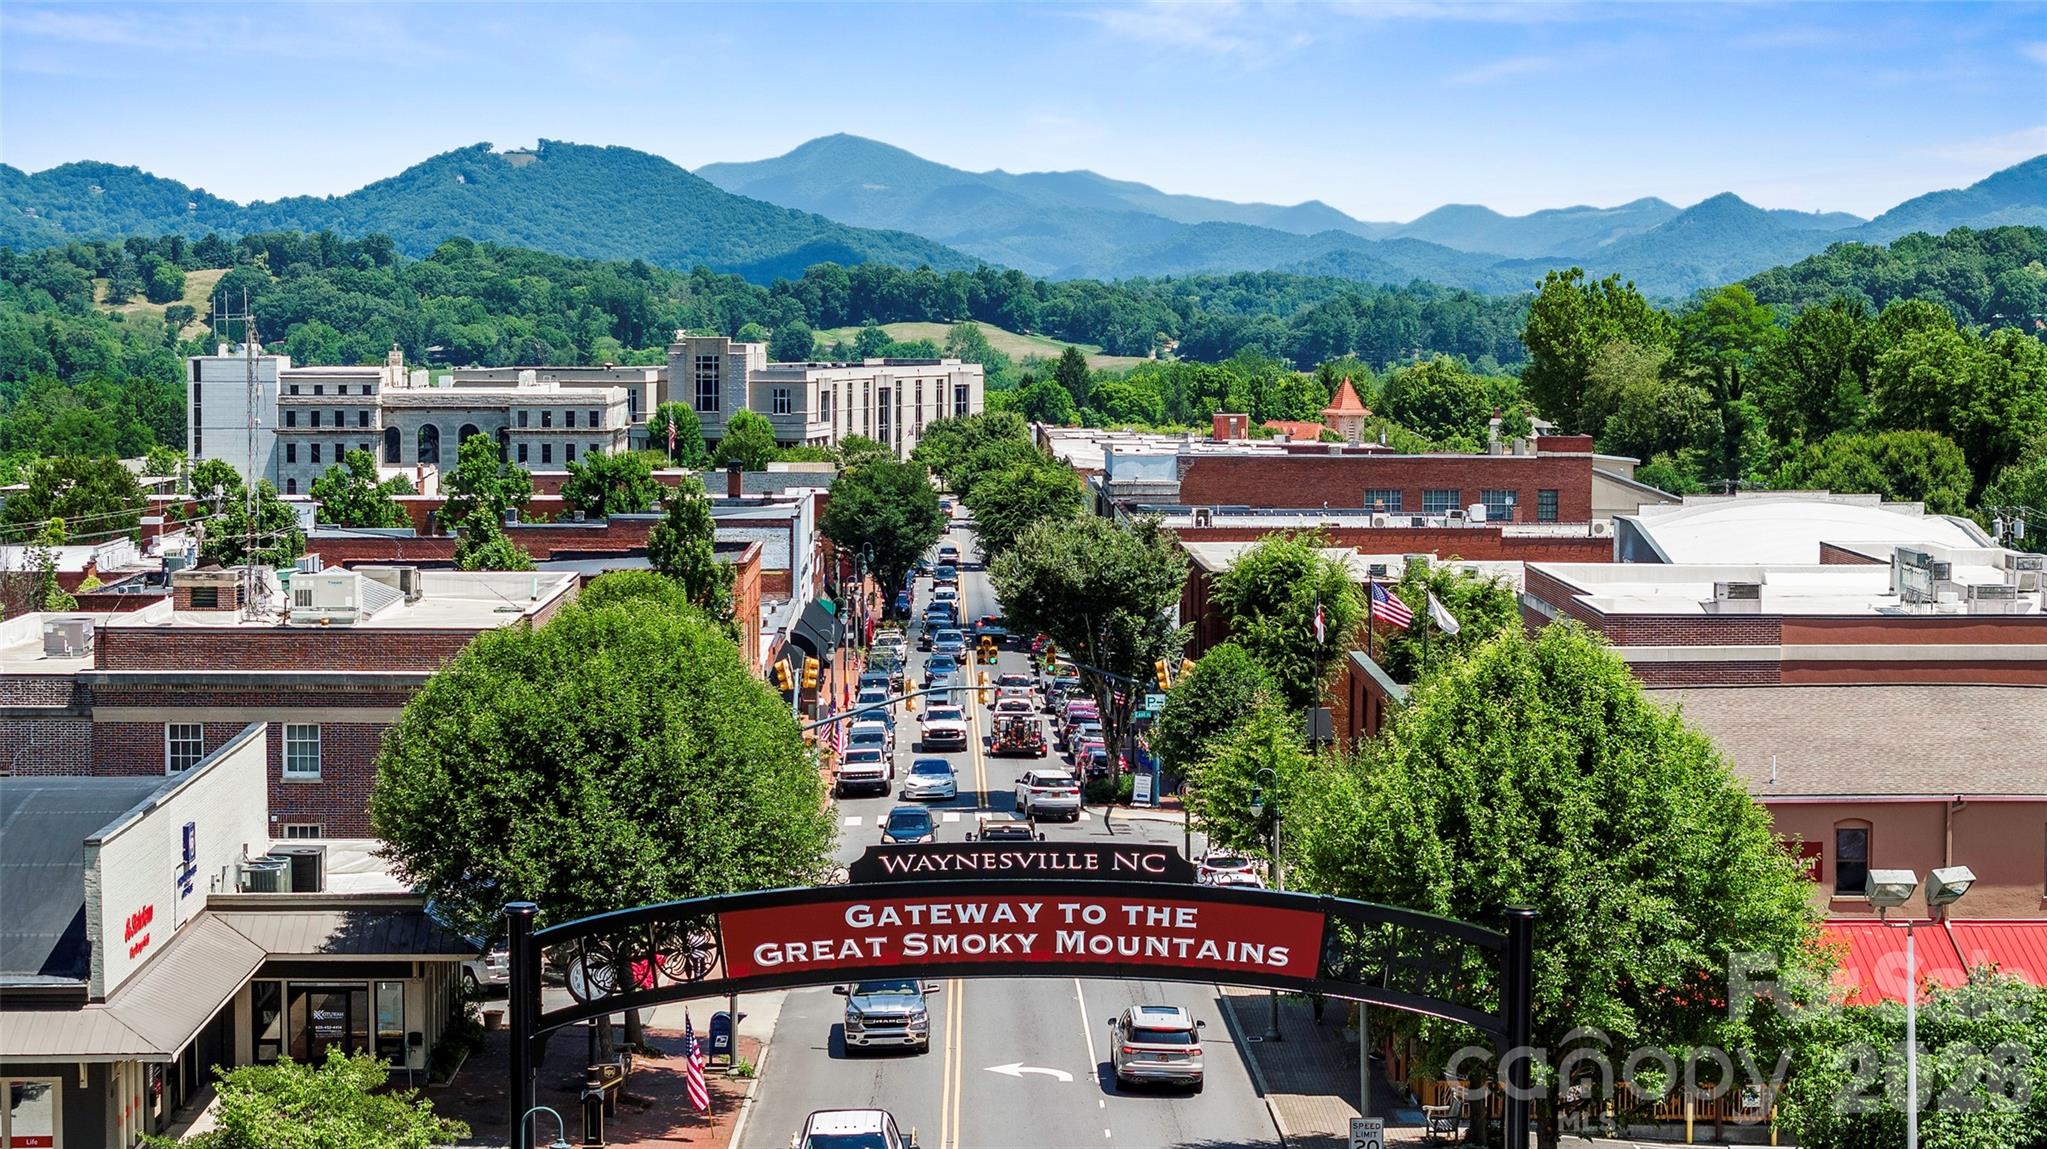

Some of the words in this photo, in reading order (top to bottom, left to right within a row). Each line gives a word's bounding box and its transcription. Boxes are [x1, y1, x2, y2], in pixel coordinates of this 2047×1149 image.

[878, 852, 1098, 874] WAYNESVILLE
[1112, 852, 1166, 873] NC
[845, 903, 1043, 928] GATEWAY
[1058, 903, 1107, 925] TO
[1122, 905, 1198, 928] THE
[753, 936, 888, 967] GREAT
[903, 932, 1038, 957] SMOKY
[1055, 930, 1290, 967] MOUNTAINS
[1354, 1139, 1380, 1149] 20
